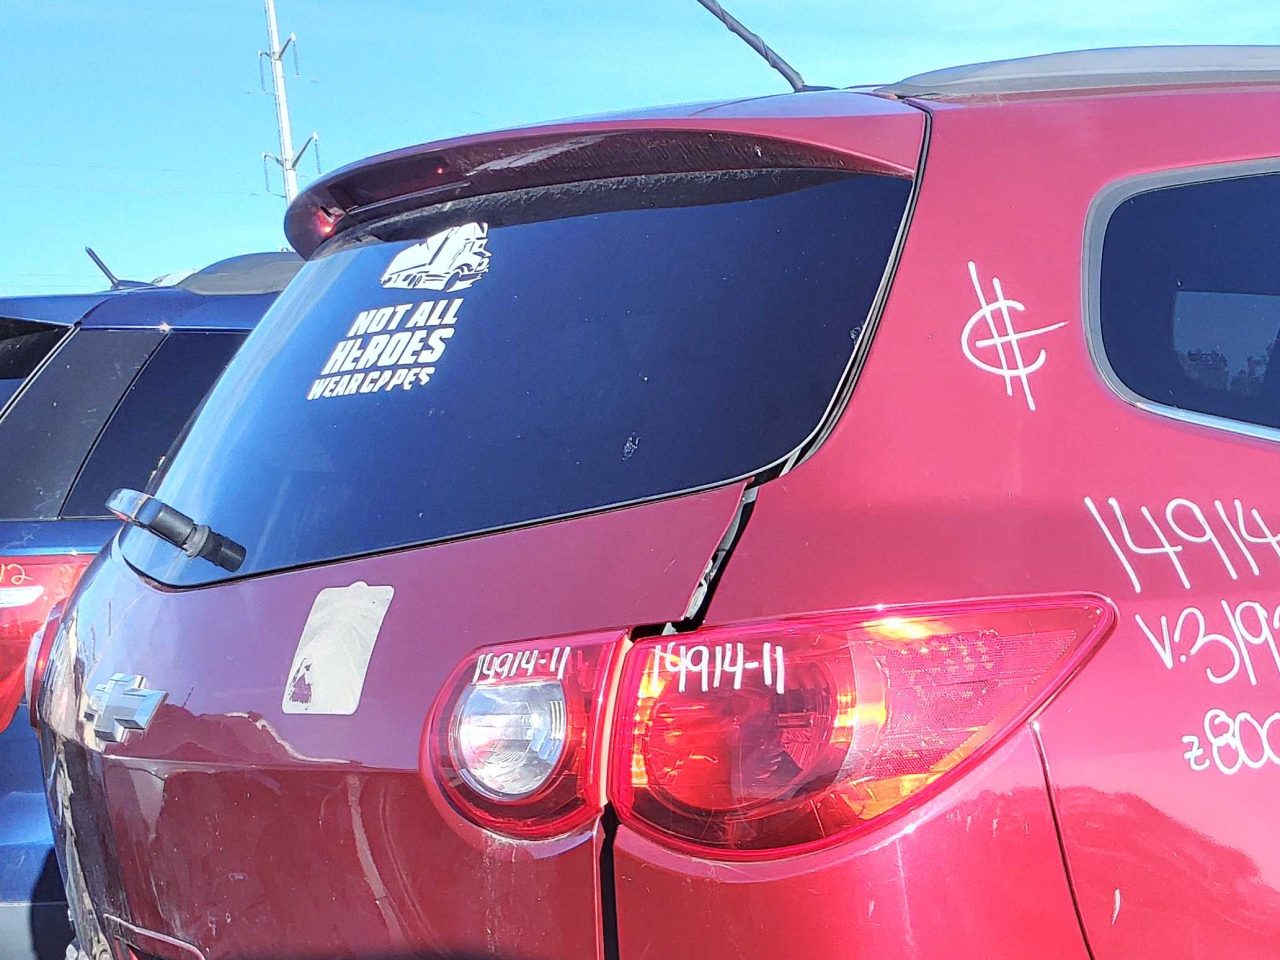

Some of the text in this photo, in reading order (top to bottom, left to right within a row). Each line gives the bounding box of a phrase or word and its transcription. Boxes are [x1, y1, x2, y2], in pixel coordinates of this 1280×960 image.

[347, 298, 464, 337] NOT ALL
[321, 328, 455, 375] HEROES
[307, 373, 365, 400] WEAR
[471, 646, 571, 685] 14914-11
[651, 642, 785, 694] 14914-11
